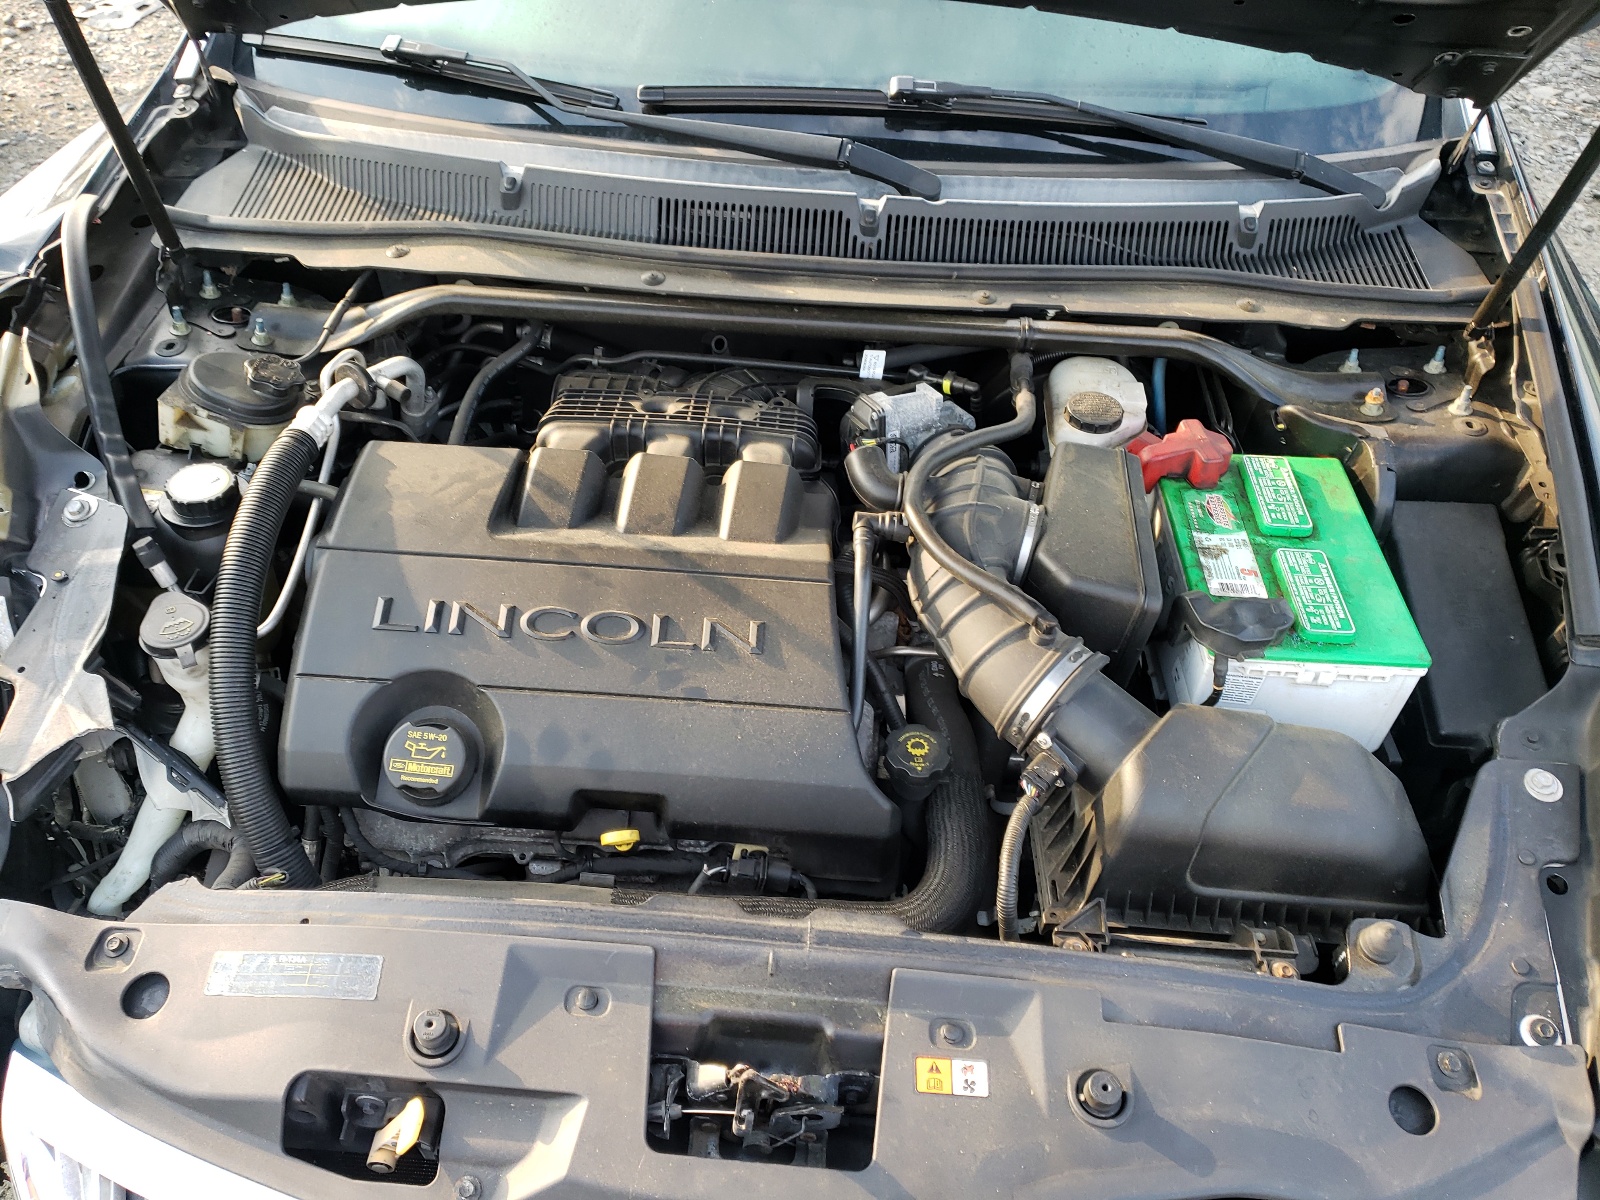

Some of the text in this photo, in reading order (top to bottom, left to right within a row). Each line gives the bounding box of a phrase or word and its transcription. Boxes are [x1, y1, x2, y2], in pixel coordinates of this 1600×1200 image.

[371, 596, 766, 654] LINCOLN
[408, 730, 448, 741] SAE 5W-20
[407, 762, 452, 776] Motorcraft
